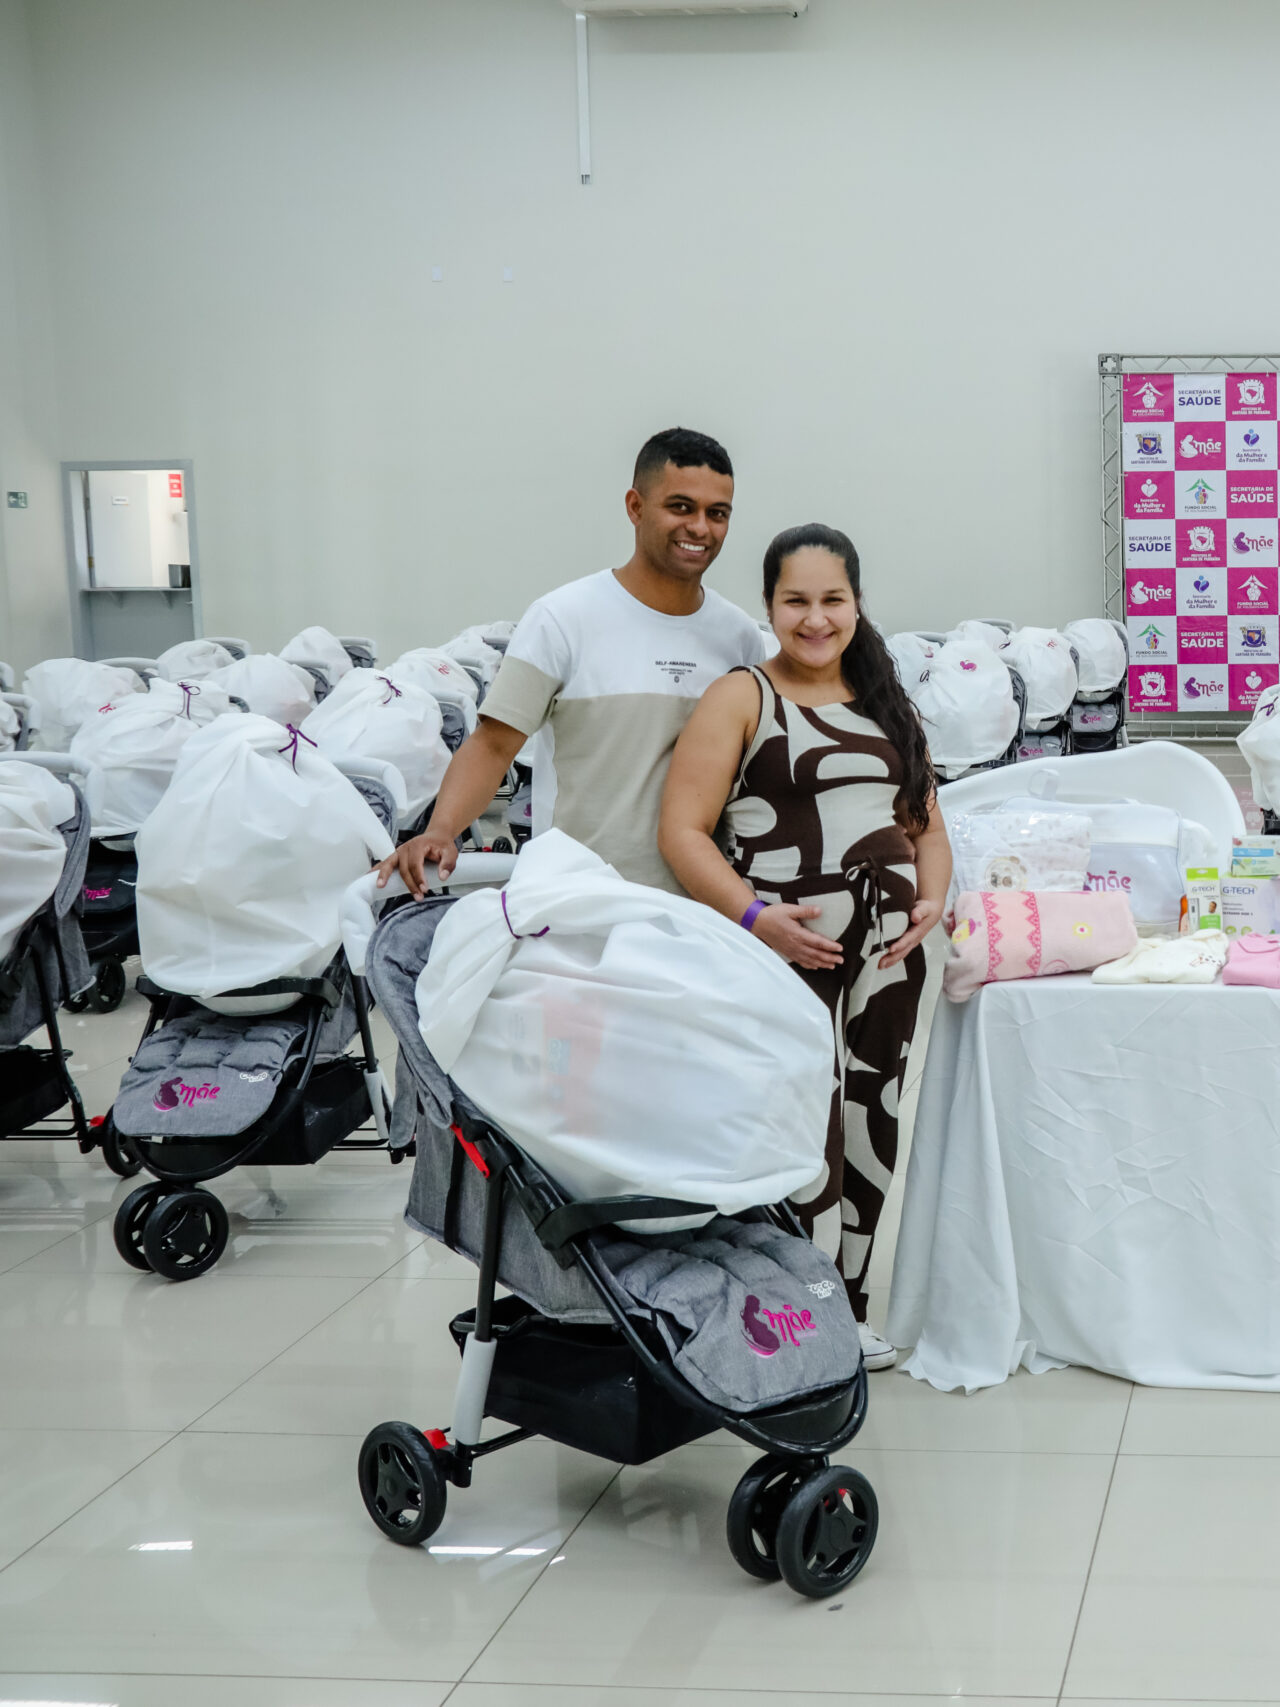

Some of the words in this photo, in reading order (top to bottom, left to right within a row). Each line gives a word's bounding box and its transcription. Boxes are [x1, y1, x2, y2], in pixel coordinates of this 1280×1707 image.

[1178, 394, 1222, 406] SAÚDE
[1193, 439, 1221, 454] mãe
[1231, 492, 1274, 503] SAÚDE
[1129, 540, 1172, 552] SAÚDE
[1246, 536, 1273, 551] mãe
[1144, 585, 1172, 601] mãe
[1181, 637, 1224, 648] SAÚDE
[1197, 681, 1224, 696] mãe
[1086, 869, 1131, 892] mãe
[1222, 886, 1255, 895] G-TECH
[180, 1083, 221, 1108] mãe
[762, 1304, 817, 1347] mãe
